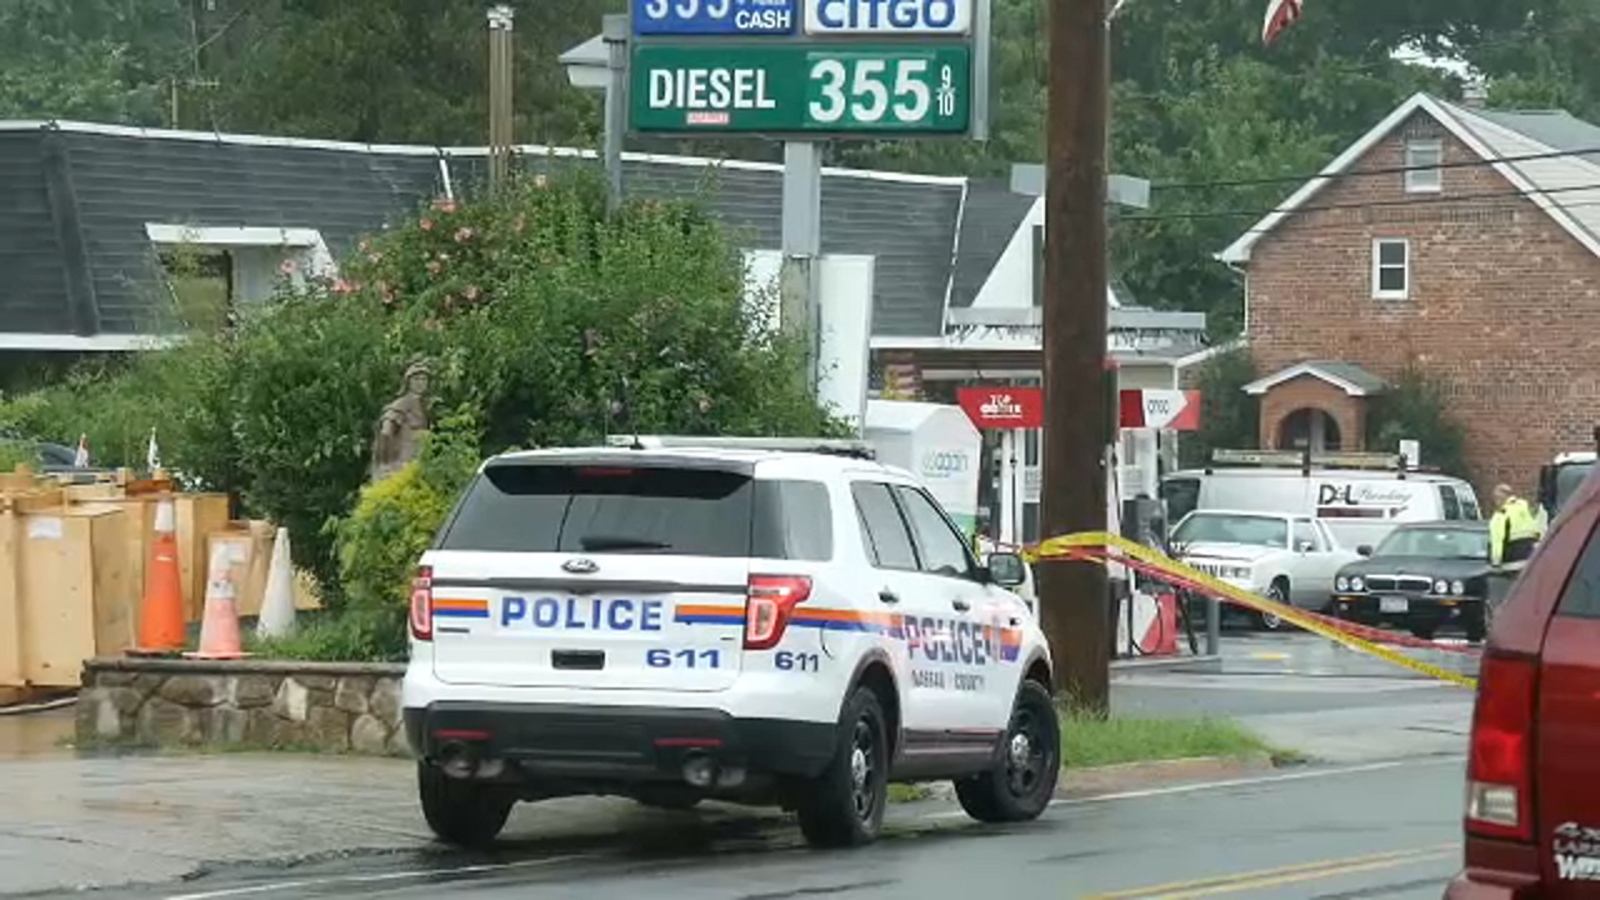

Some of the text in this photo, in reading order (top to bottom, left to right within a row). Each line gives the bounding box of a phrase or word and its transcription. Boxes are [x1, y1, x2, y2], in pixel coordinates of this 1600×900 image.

[735, 9, 791, 29] CASH
[817, 0, 956, 28] CITGO
[650, 59, 931, 122] DIESEL 355
[500, 596, 663, 632] POLICE
[904, 614, 986, 666] POLICE
[646, 649, 721, 669] 611
[774, 651, 820, 673] 611
